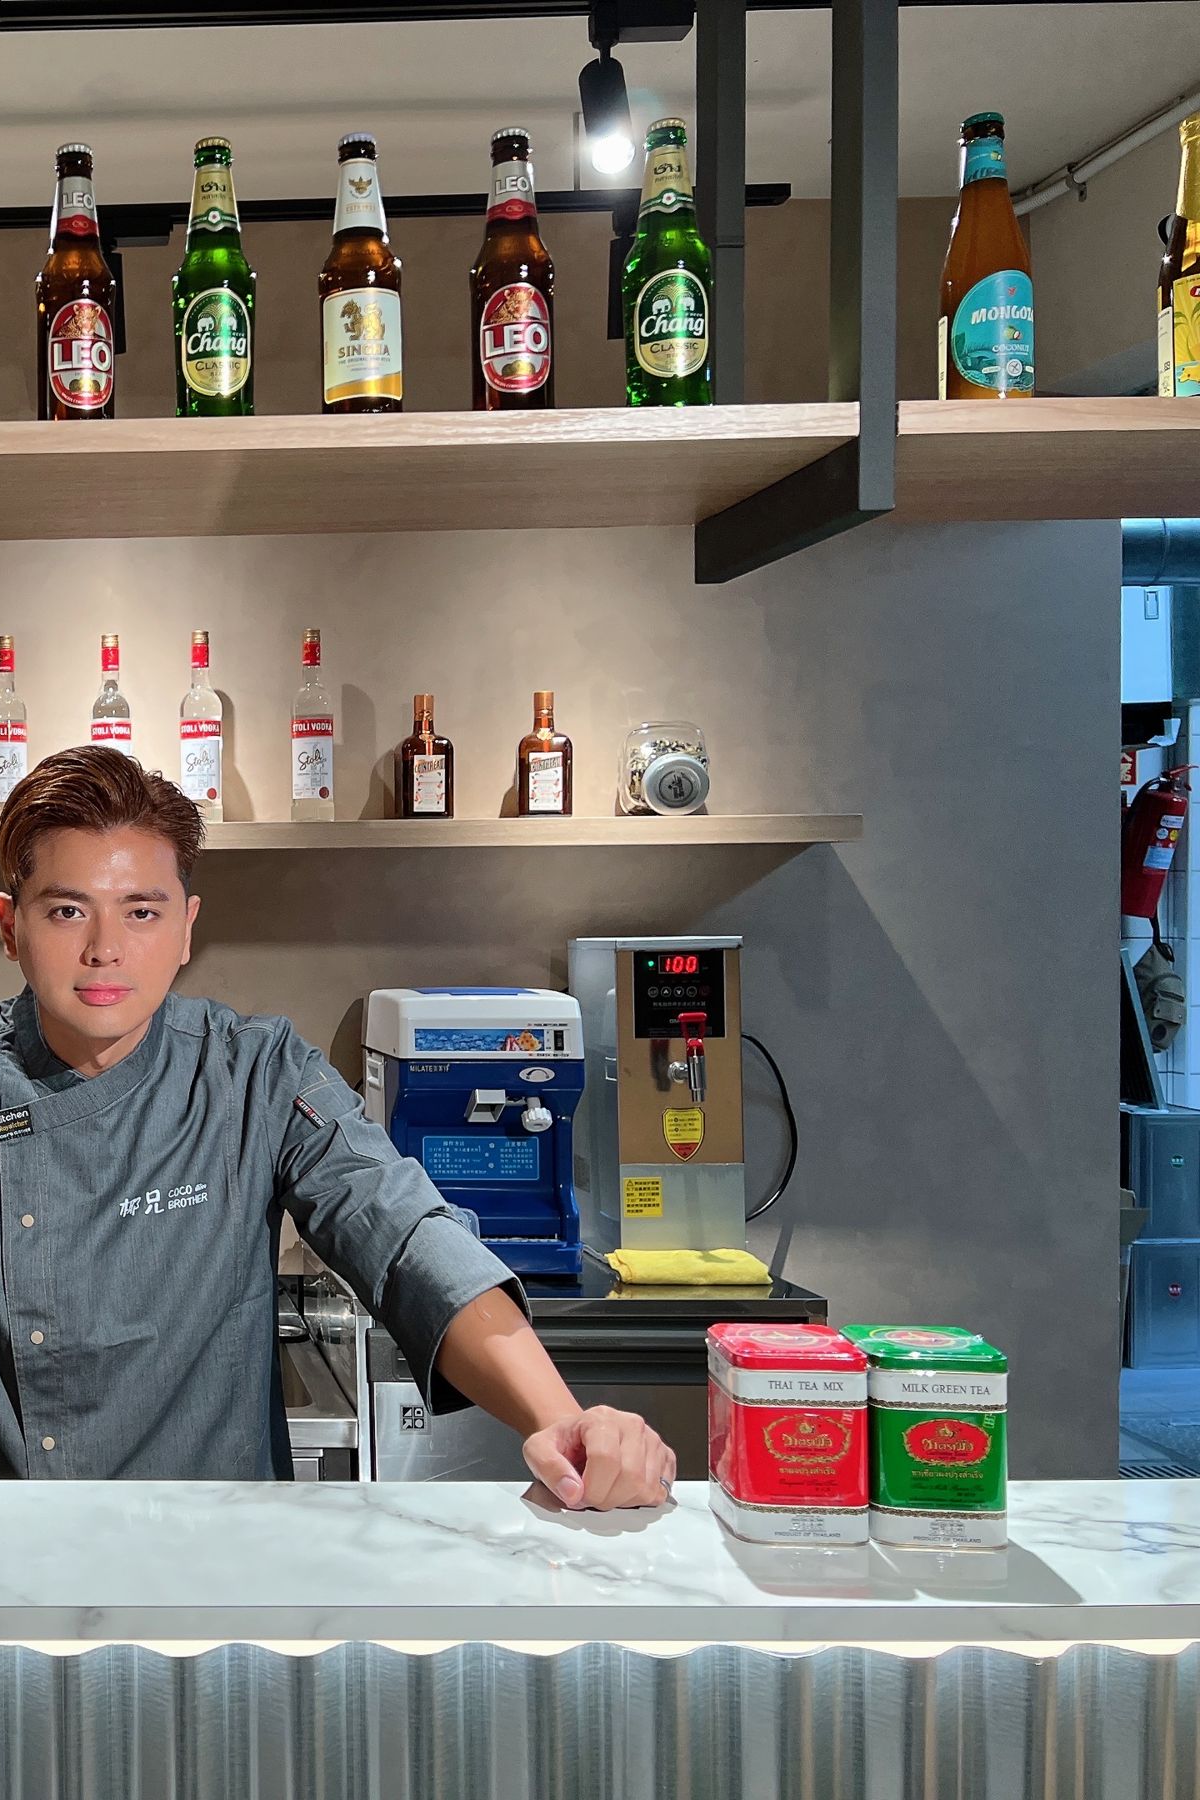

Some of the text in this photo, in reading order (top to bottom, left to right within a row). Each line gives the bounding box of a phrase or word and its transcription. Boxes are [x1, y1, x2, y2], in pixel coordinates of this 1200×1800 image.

[495, 176, 530, 196] LEO
[62, 192, 94, 210] LEO
[640, 314, 705, 338] Chang
[187, 333, 247, 356] Chang
[484, 323, 548, 358] LEO
[992, 344, 1030, 353] COCONUT
[53, 340, 112, 372] LEO
[666, 956, 698, 973] 100
[168, 1185, 193, 1198] COCO
[168, 1193, 208, 1210] BROTHER
[768, 1380, 844, 1392] THAI TEA MIX
[902, 1383, 991, 1395] MILK GREEN TEA
